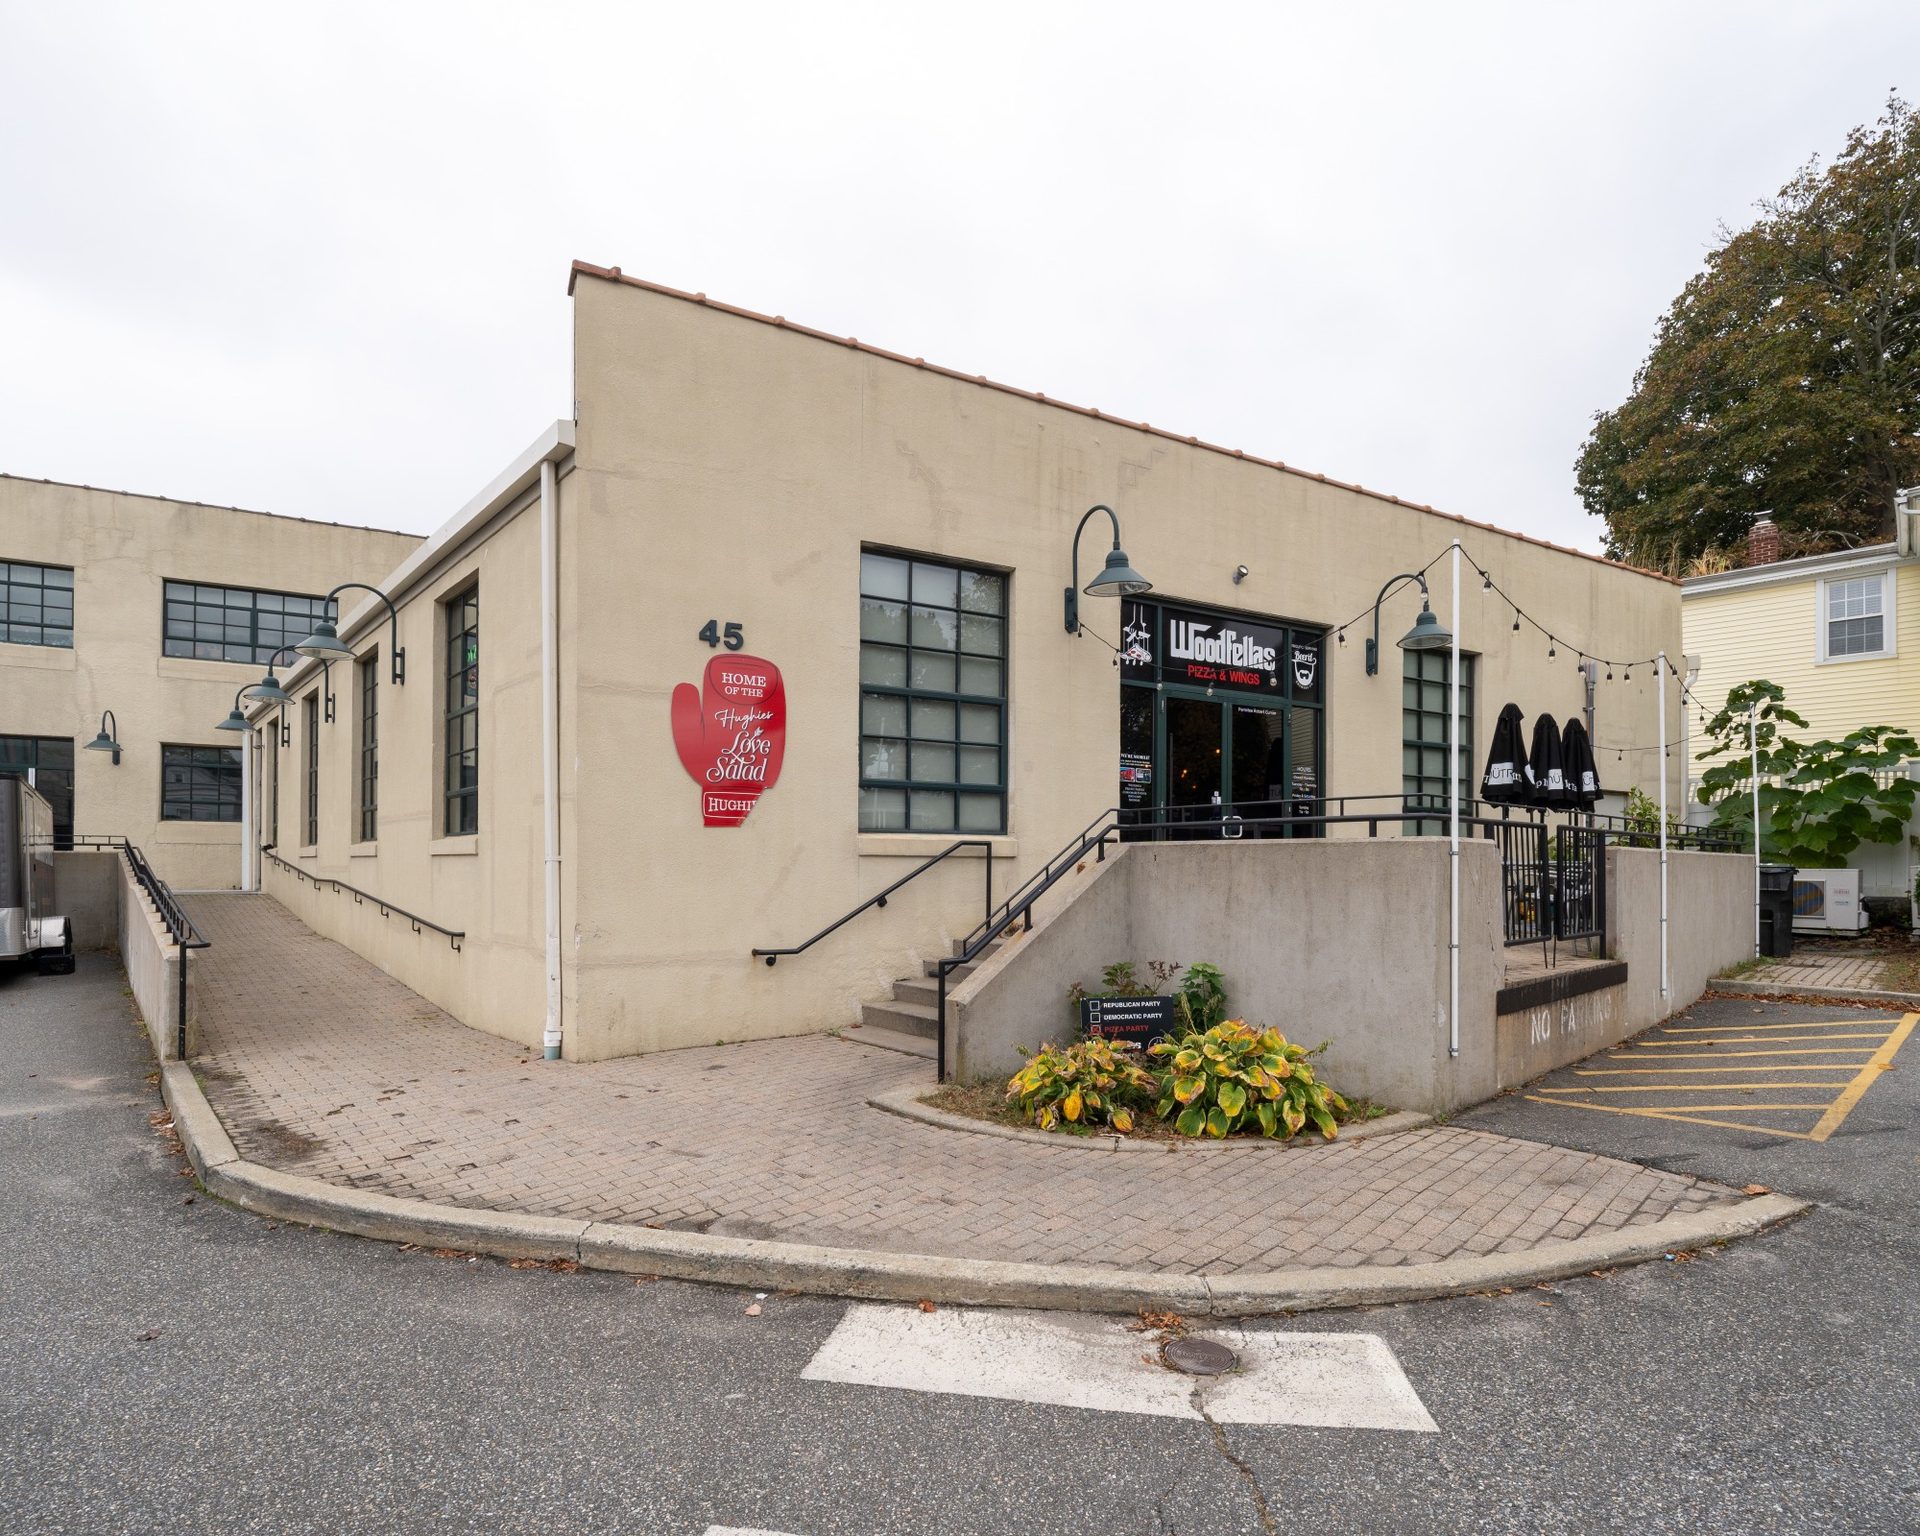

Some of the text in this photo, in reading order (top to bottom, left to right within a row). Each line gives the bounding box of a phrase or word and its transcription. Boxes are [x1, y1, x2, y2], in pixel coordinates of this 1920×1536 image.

[698, 619, 744, 651] 45
[1170, 619, 1276, 671] Woodfellas
[722, 672, 767, 688] HOME
[1187, 664, 1260, 686] PIZZA & WINGS
[724, 687, 763, 698] OF THE
[714, 706, 773, 730] Hughies
[721, 730, 771, 757] Love
[706, 755, 767, 783] Salad
[1531, 1009, 1551, 1045] NO
